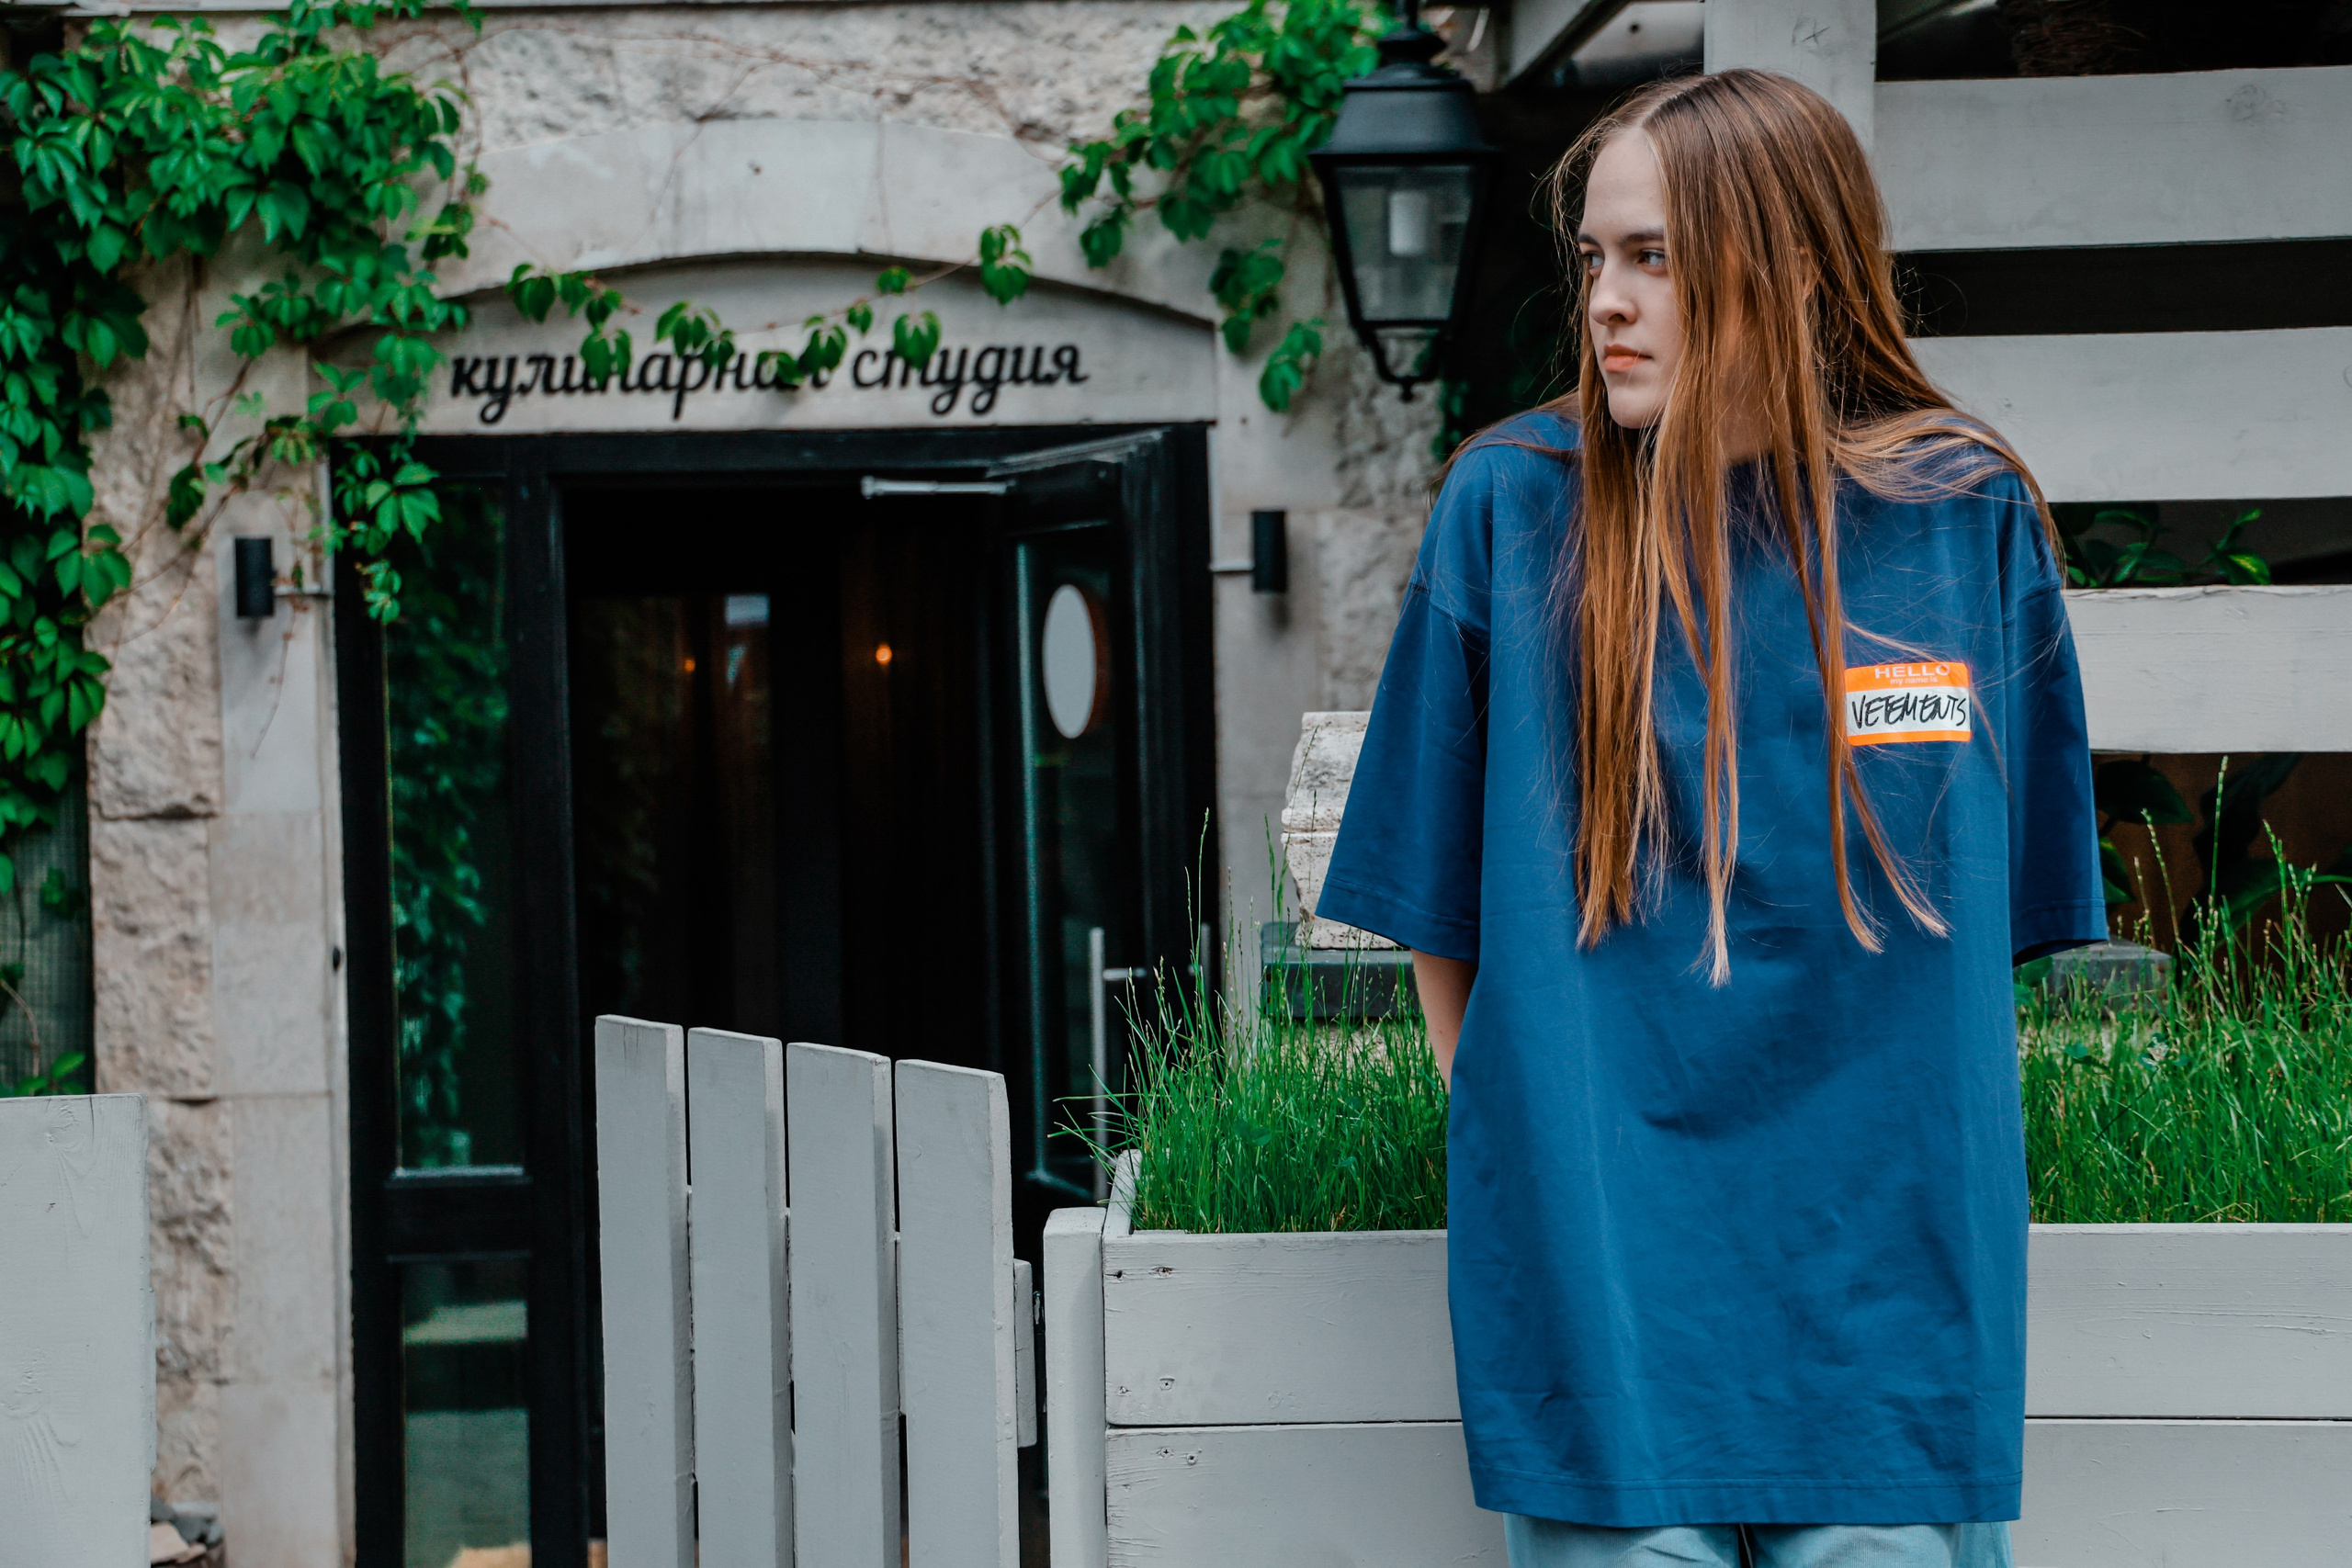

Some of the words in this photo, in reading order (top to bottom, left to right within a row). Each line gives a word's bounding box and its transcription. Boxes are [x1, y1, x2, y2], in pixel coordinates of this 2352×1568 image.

[852, 344, 1090, 416] студия
[1874, 663, 1951, 680] HELLO
[1890, 677, 1904, 686] my
[1905, 676, 1928, 684] name
[1851, 692, 1967, 729] VETEMENTS
